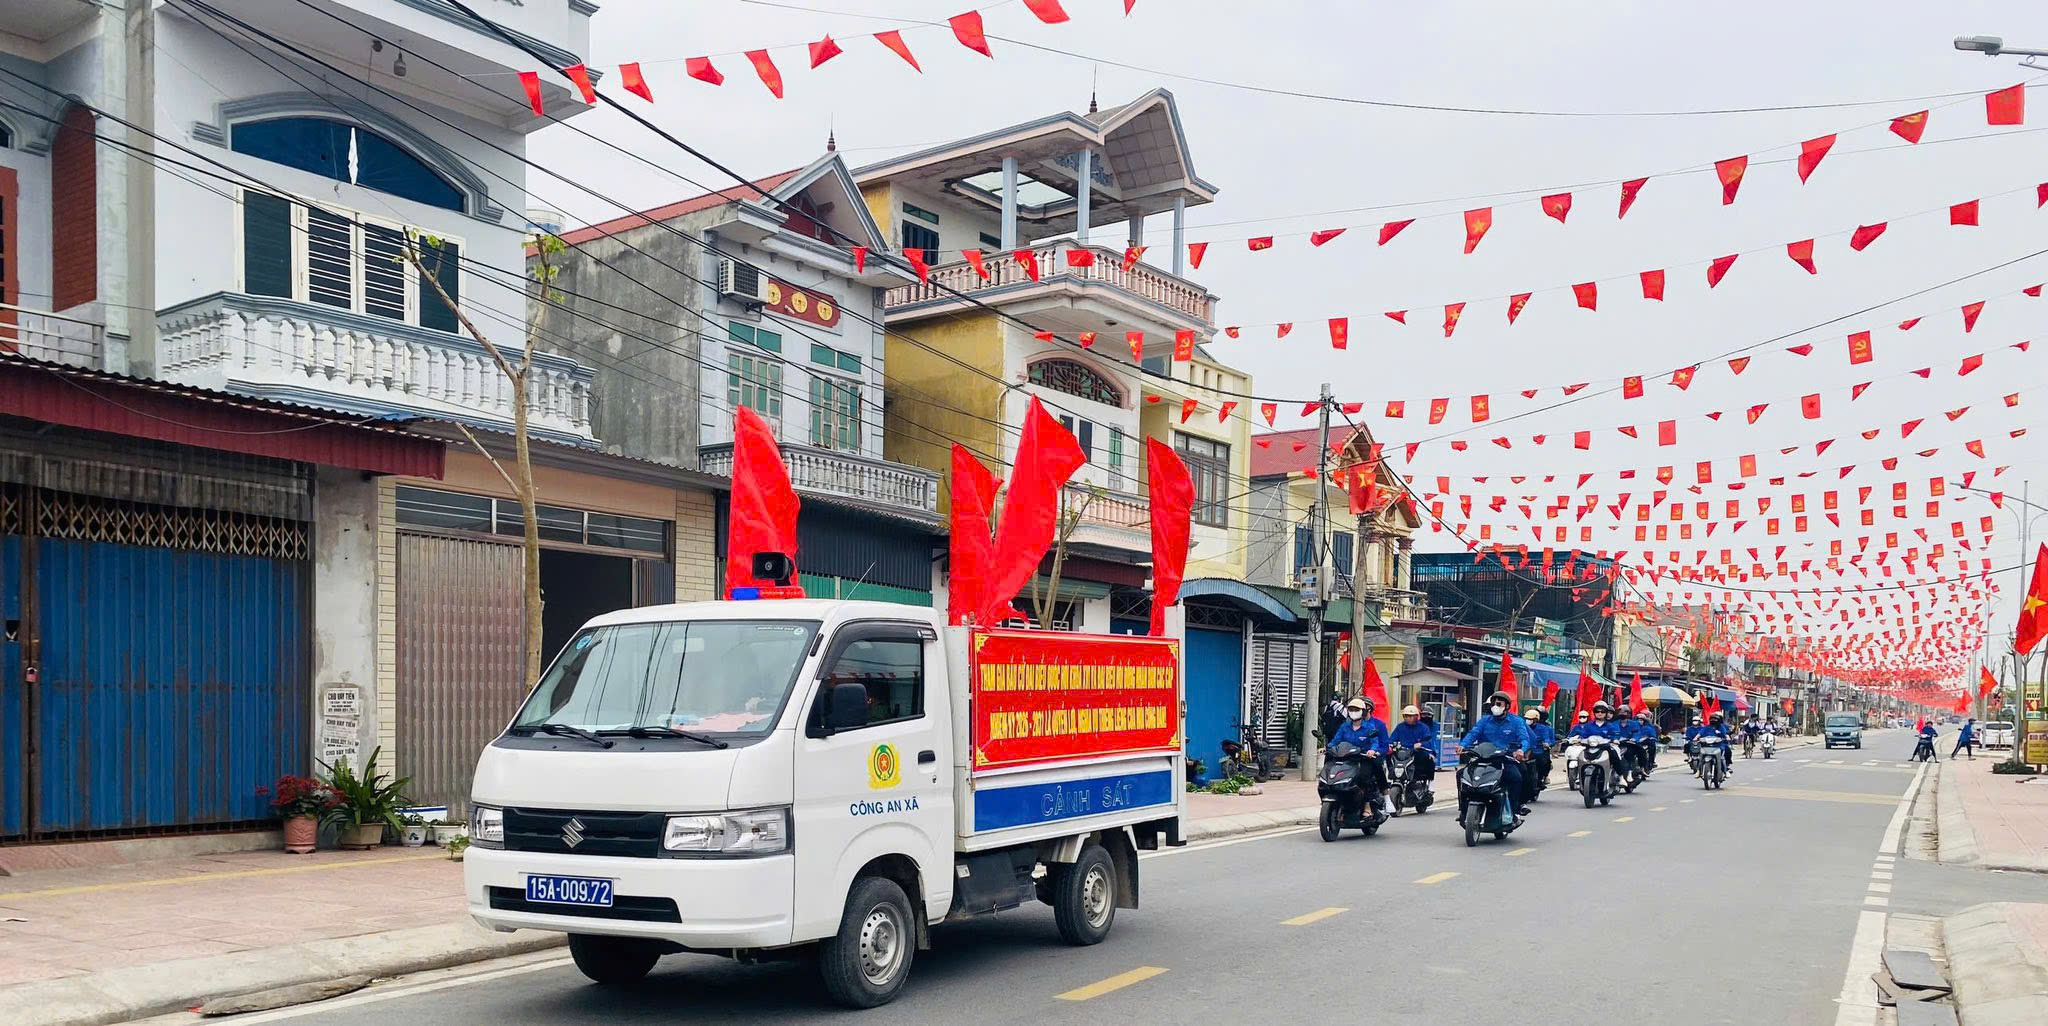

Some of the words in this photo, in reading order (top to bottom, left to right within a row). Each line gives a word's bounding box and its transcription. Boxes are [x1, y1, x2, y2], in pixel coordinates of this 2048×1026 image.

[850, 800, 883, 816] CÔNG
[887, 800, 902, 813] AN
[904, 796, 919, 811] XÃ
[1041, 785, 1091, 817] CẢNH
[1102, 781, 1132, 808] SÁT
[530, 877, 610, 904] 15A-009.72
